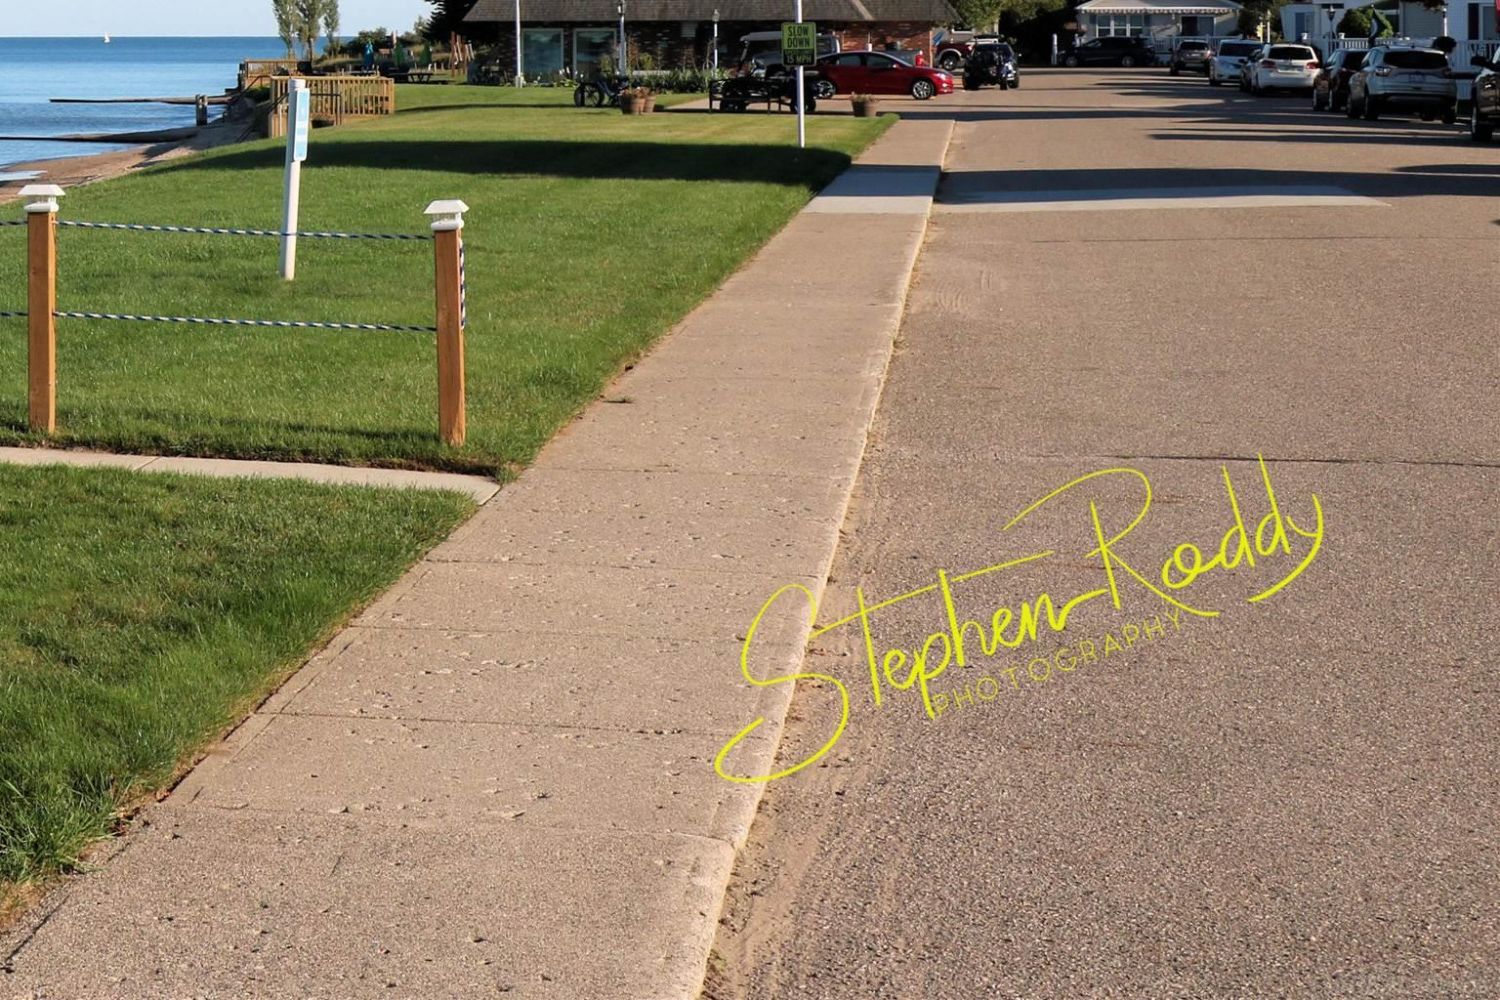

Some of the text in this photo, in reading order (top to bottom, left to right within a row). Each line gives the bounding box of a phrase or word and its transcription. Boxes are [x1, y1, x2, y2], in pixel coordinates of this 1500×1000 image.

[787, 25, 809, 37] SLOW
[787, 37, 810, 48] DOWN
[786, 55, 795, 64] 15
